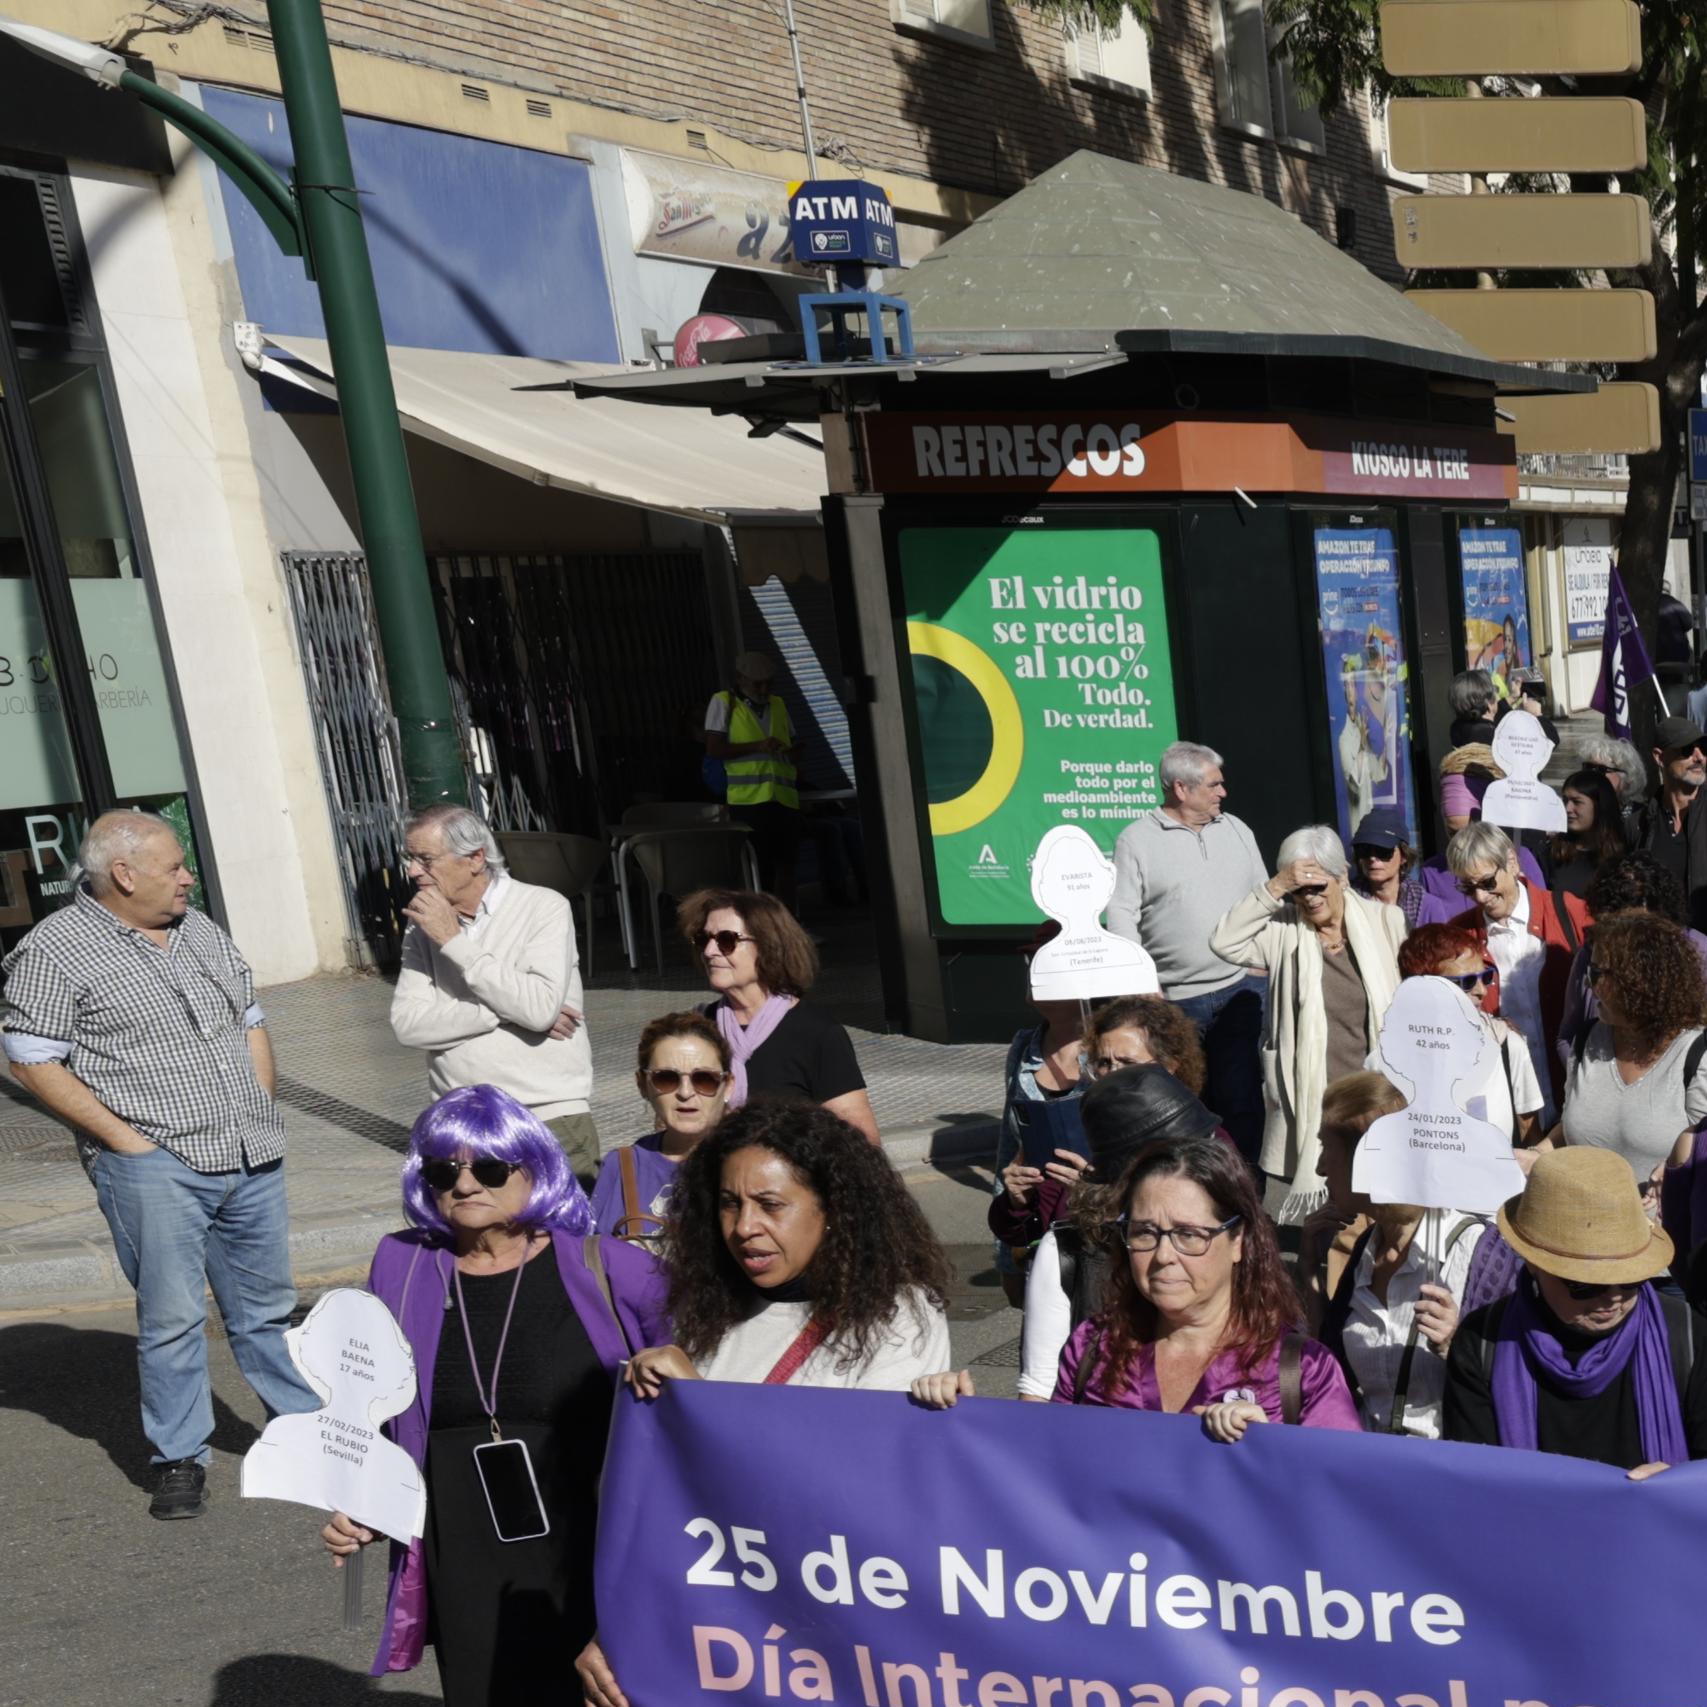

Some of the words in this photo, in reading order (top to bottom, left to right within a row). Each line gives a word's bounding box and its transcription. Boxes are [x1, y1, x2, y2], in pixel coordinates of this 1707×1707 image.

[795, 196, 858, 221] ATM
[866, 199, 894, 228] ATM
[912, 423, 1145, 478] REFRESCOS
[1351, 440, 1408, 478] KIOSCO
[1413, 443, 1432, 479] LA
[1434, 447, 1469, 480] TERE
[988, 576, 1026, 609] El
[1032, 576, 1142, 610] vidrio
[993, 621, 1027, 644] se
[1034, 613, 1146, 645] recicla
[1015, 645, 1047, 678] al
[1056, 645, 1149, 680] 100%
[1078, 682, 1151, 705] Todo.
[1043, 709, 1072, 728] De
[1076, 708, 1153, 728] verdad.
[1061, 760, 1112, 775] Porque
[1116, 760, 1154, 773] darlo
[1075, 776, 1109, 788] todo
[1114, 778, 1138, 791] por
[1142, 776, 1155, 788] el
[1044, 792, 1157, 803] medioambiente
[1062, 809, 1078, 818] es
[1083, 807, 1096, 818] lo
[1069, 956, 1104, 967] (Tenerife)
[1408, 1024, 1434, 1035] RUTH
[1436, 1027, 1454, 1036] R.P.
[1415, 1039, 1427, 1048] 42
[1428, 1040, 1450, 1050] años
[1407, 1112, 1462, 1125] 24/01/2023
[1413, 1128, 1459, 1140] PONTONS
[1409, 1139, 1465, 1152] (Barcelona)
[349, 1338, 370, 1352] ELIA
[341, 1349, 375, 1368] BAENA
[340, 1363, 351, 1373] 17
[352, 1367, 375, 1382] años
[317, 1414, 374, 1440] 27/02/2023
[320, 1430, 333, 1441] EL
[335, 1434, 368, 1454] RUBIO
[323, 1444, 364, 1467] (Sevilla)
[684, 1517, 777, 1592] 25
[801, 1535, 909, 1609] de
[940, 1545, 1465, 1645] Noviembre
[692, 1623, 834, 1702] Día
